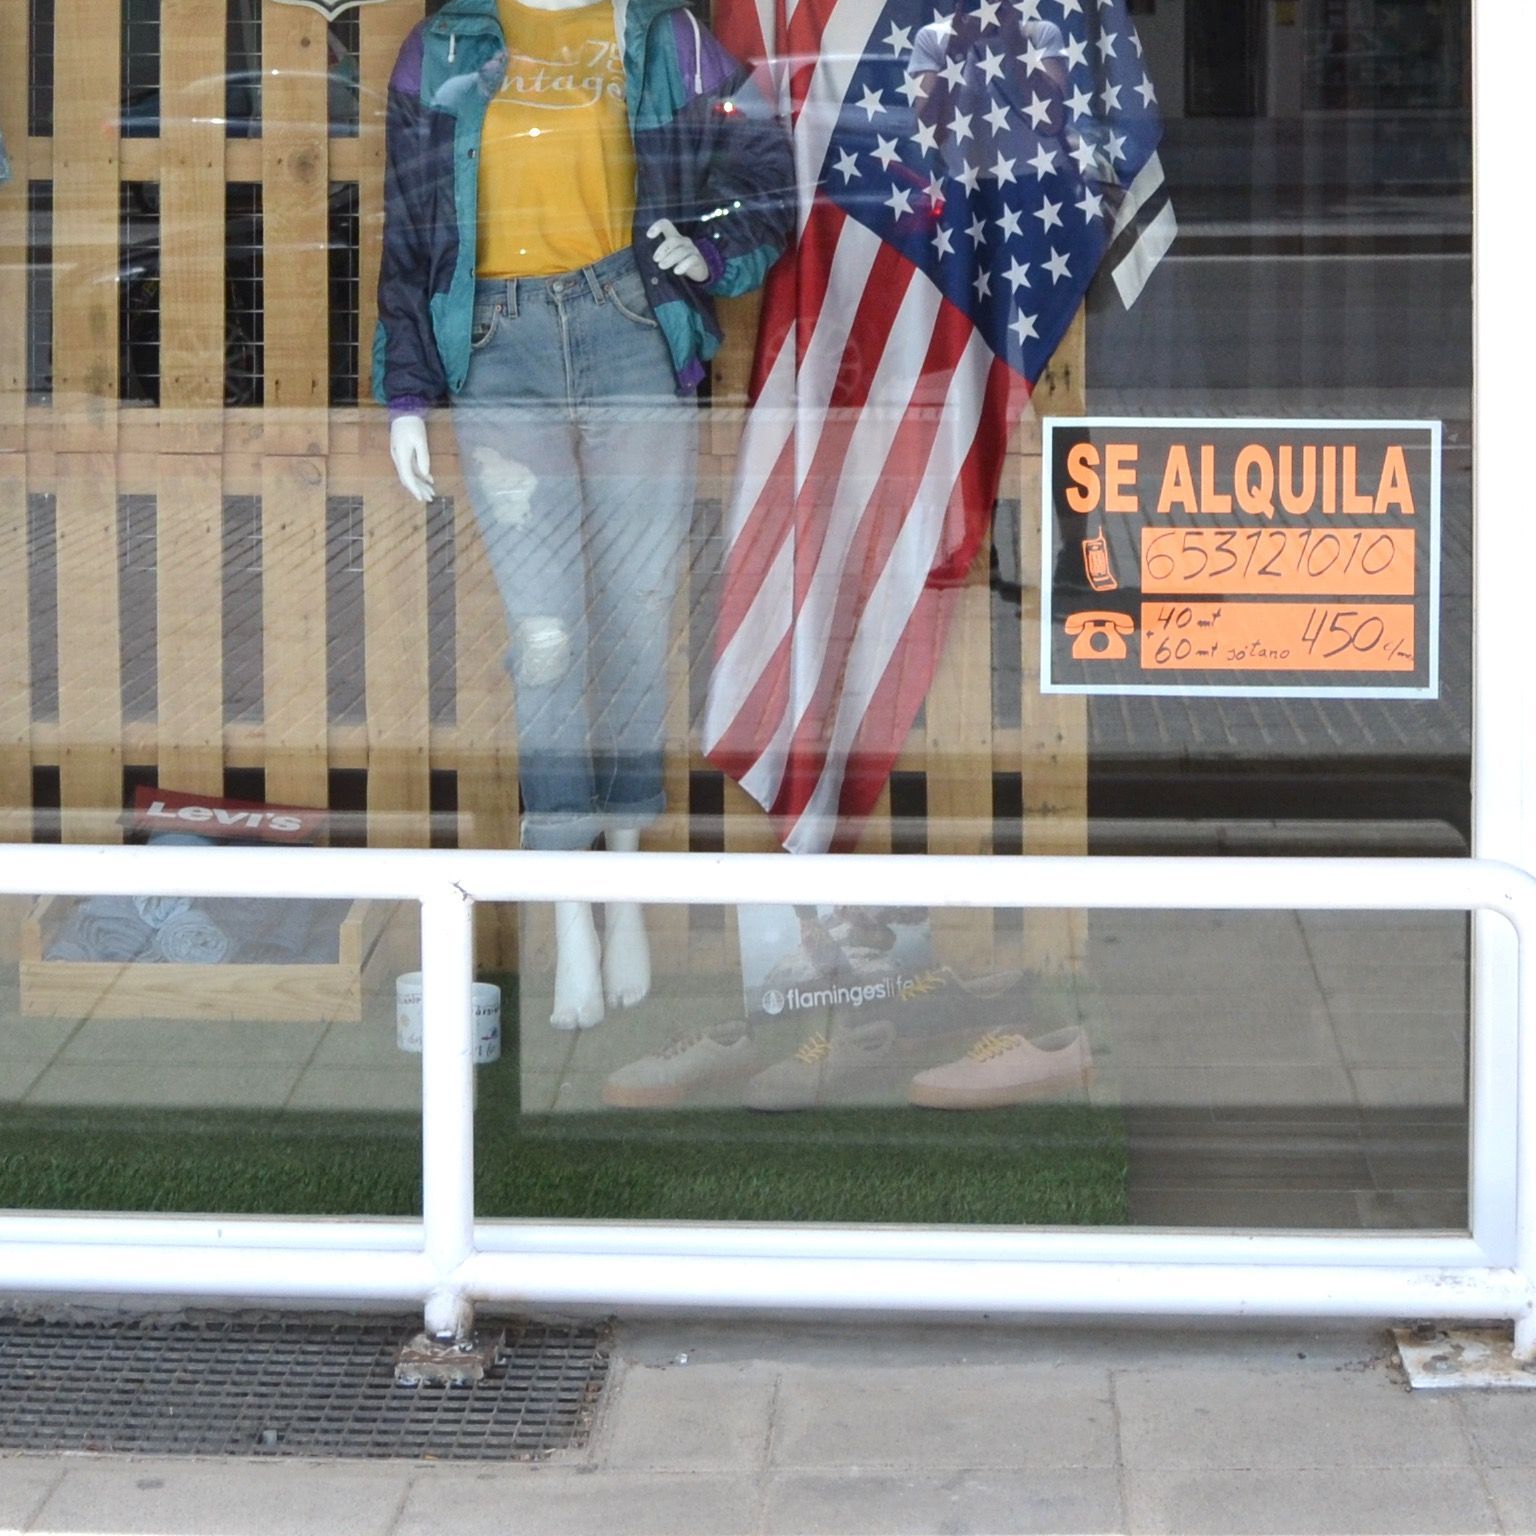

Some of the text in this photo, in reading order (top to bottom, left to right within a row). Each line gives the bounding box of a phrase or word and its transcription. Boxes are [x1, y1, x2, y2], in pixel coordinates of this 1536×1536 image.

[1066, 443, 1415, 519] SE ALQUILA
[1157, 607, 1192, 629] 40
[1302, 608, 1385, 658] 450
[1154, 638, 1192, 664] 60
